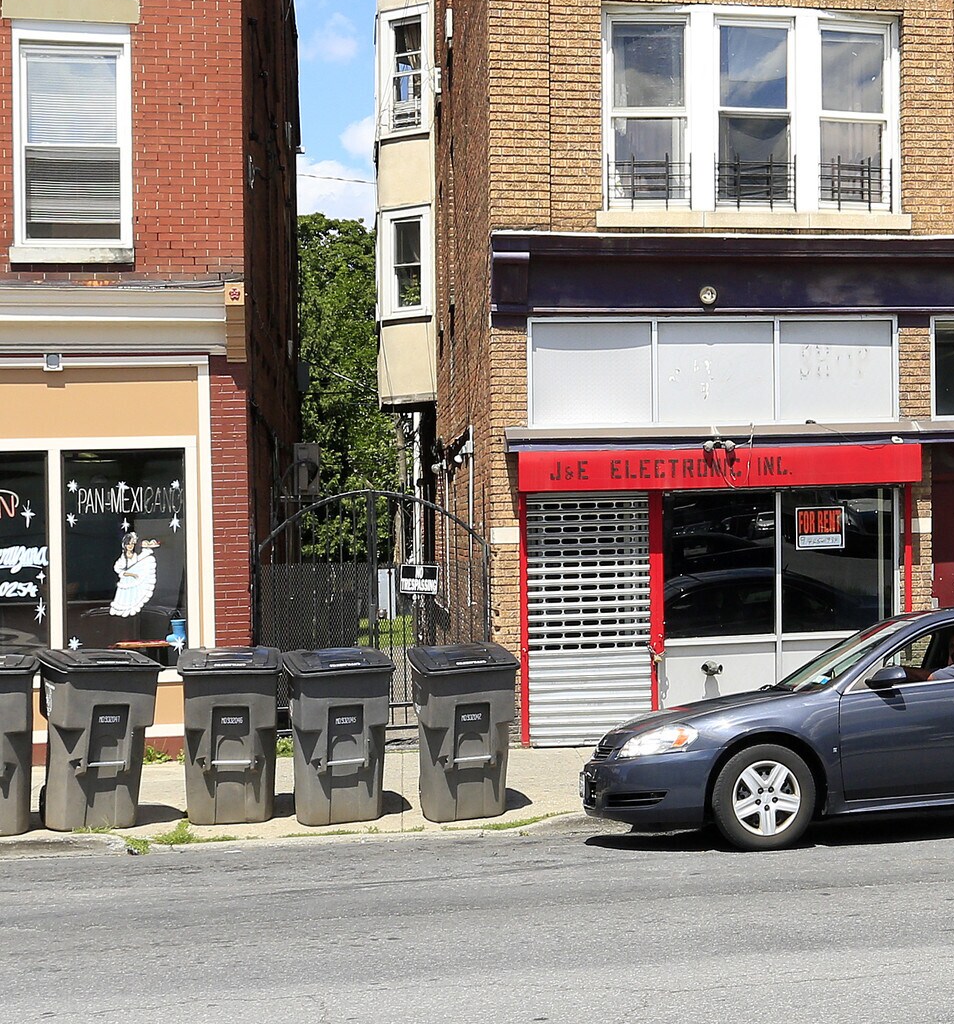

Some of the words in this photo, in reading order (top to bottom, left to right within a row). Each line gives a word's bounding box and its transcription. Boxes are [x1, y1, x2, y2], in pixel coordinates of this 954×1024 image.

[550, 460, 589, 481] J&E
[757, 456, 793, 476] INC.
[78, 486, 182, 514] PAN-MEXICANO
[799, 511, 815, 534] FOR
[818, 509, 842, 533] RENT
[401, 578, 438, 592] TRESPASSING
[415, 566, 424, 579] NO
